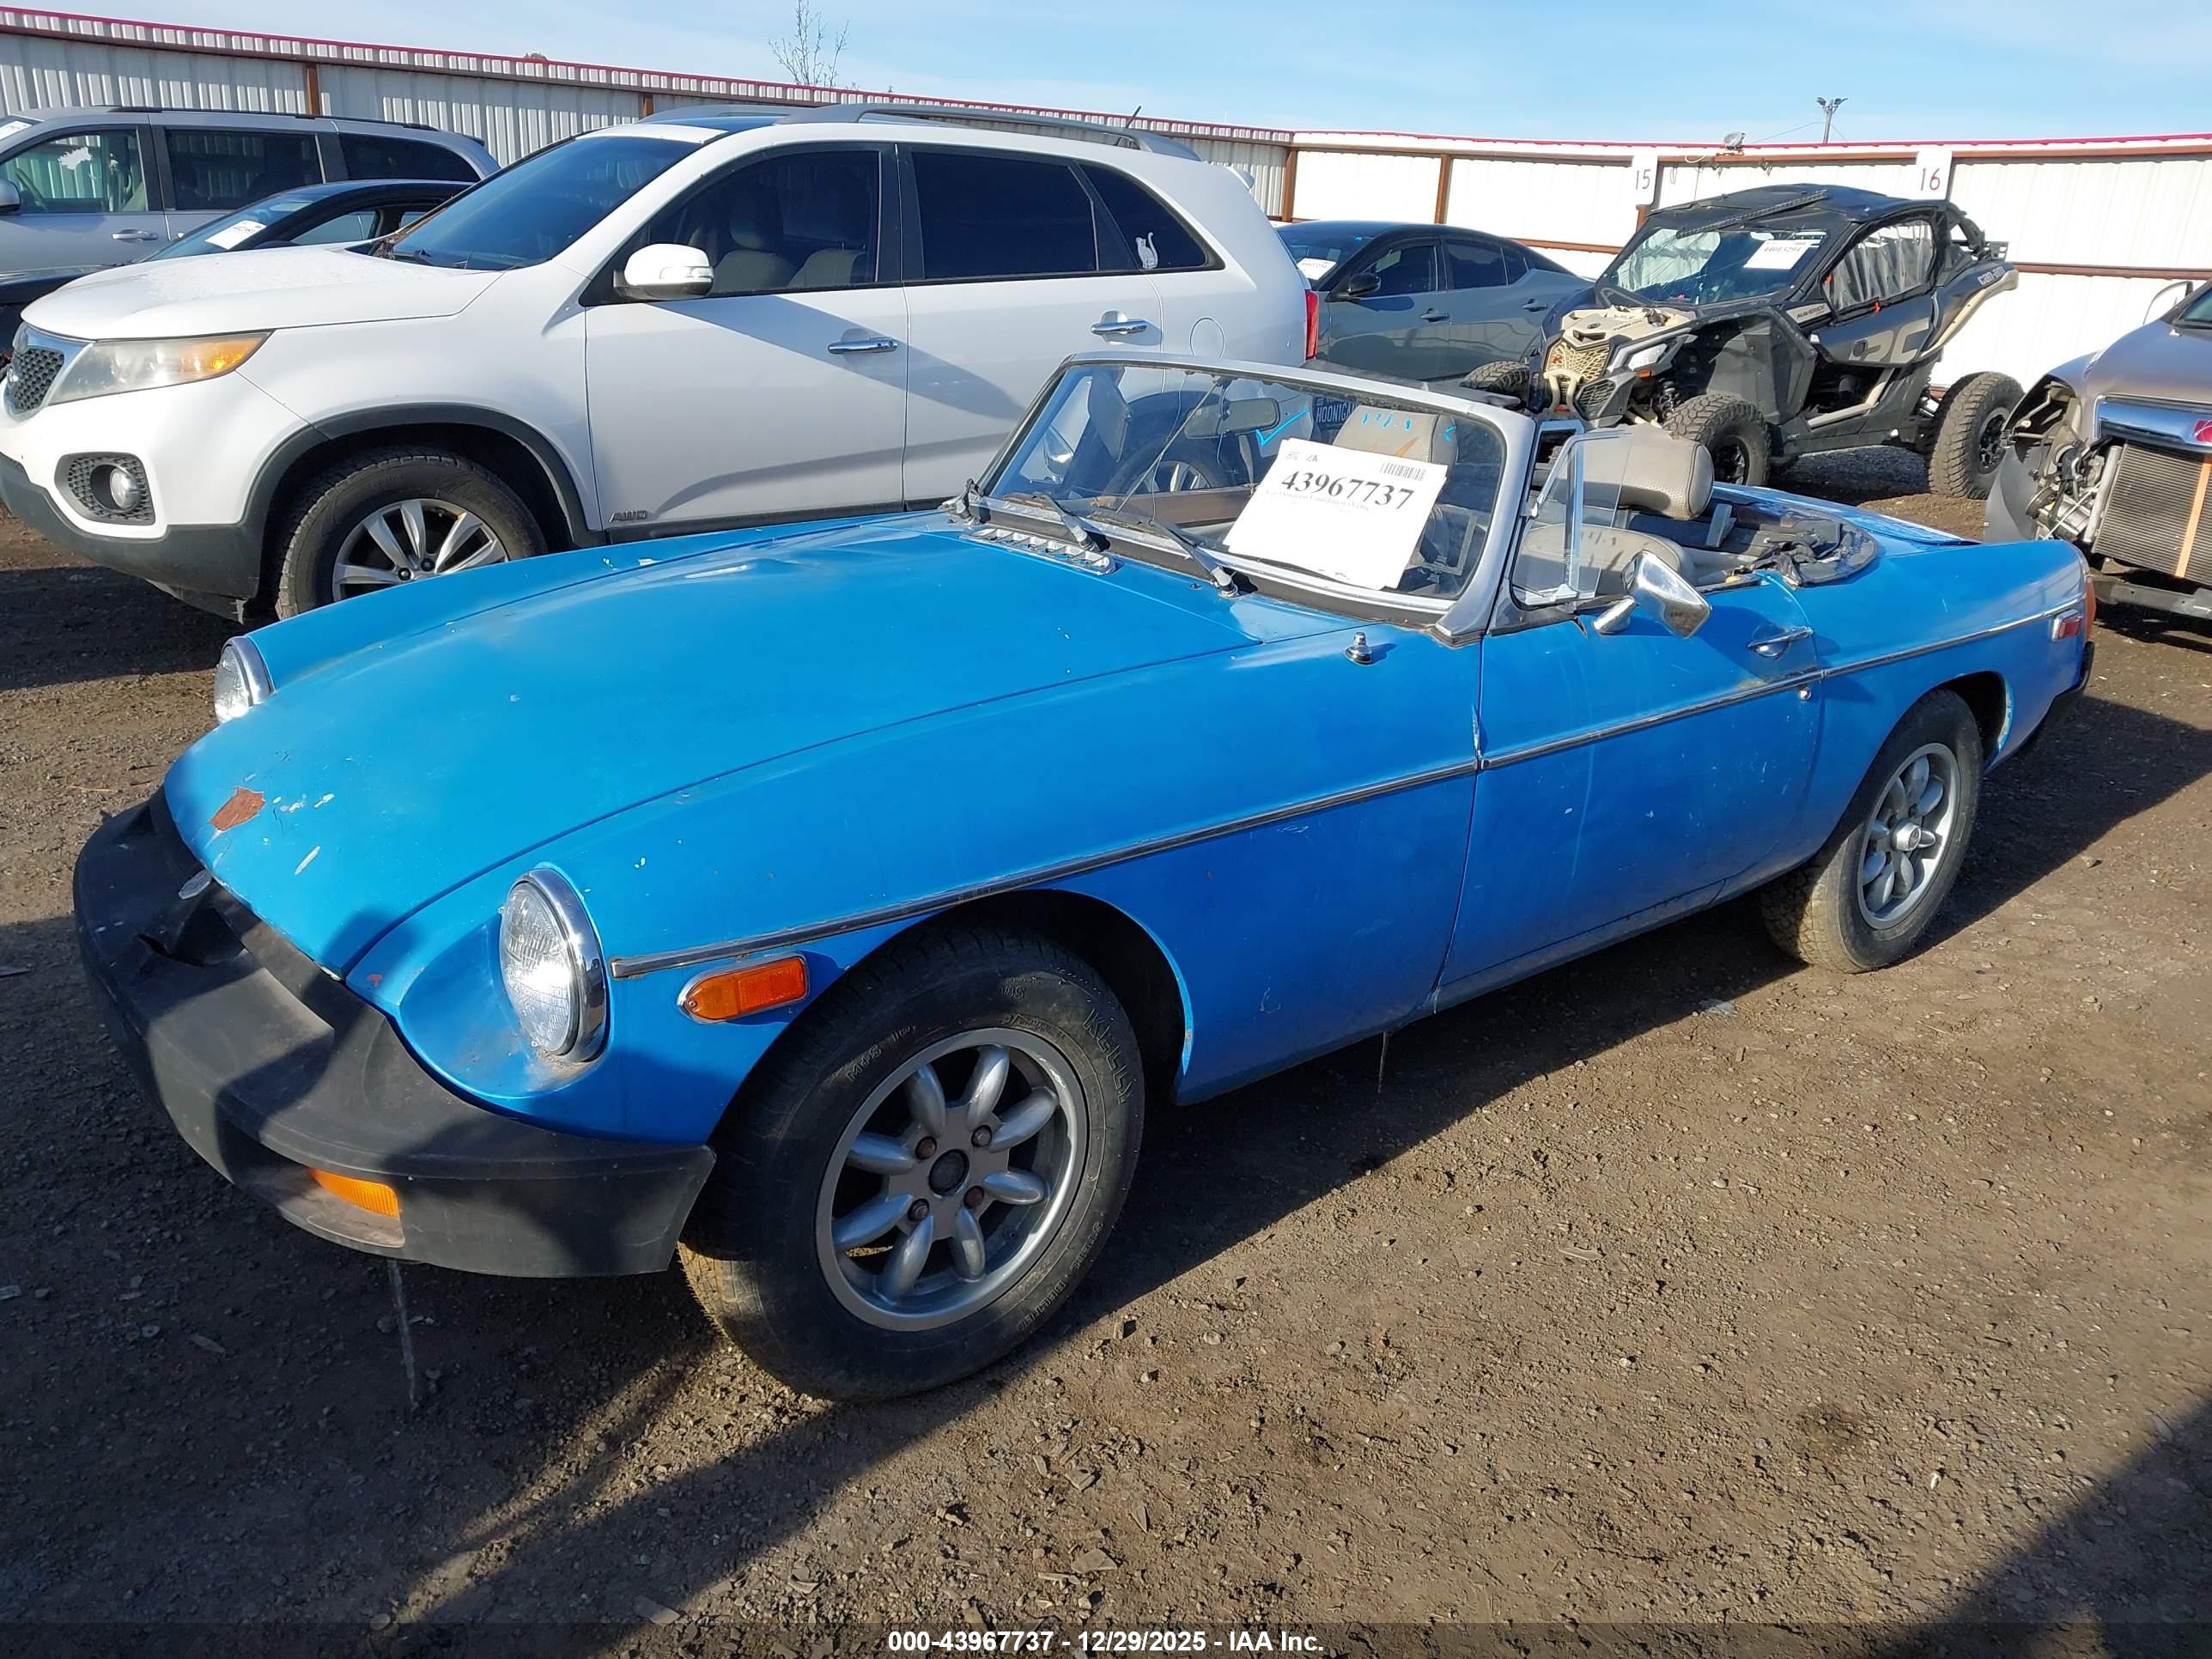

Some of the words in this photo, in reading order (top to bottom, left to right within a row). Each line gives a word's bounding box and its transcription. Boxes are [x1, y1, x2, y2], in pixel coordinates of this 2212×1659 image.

[1634, 167, 1651, 191] 15
[1919, 165, 1942, 191] 16
[1281, 471, 1415, 510] 43967737
[845, 1044, 884, 1083] M+S
[1082, 1006, 1138, 1105] KELLY
